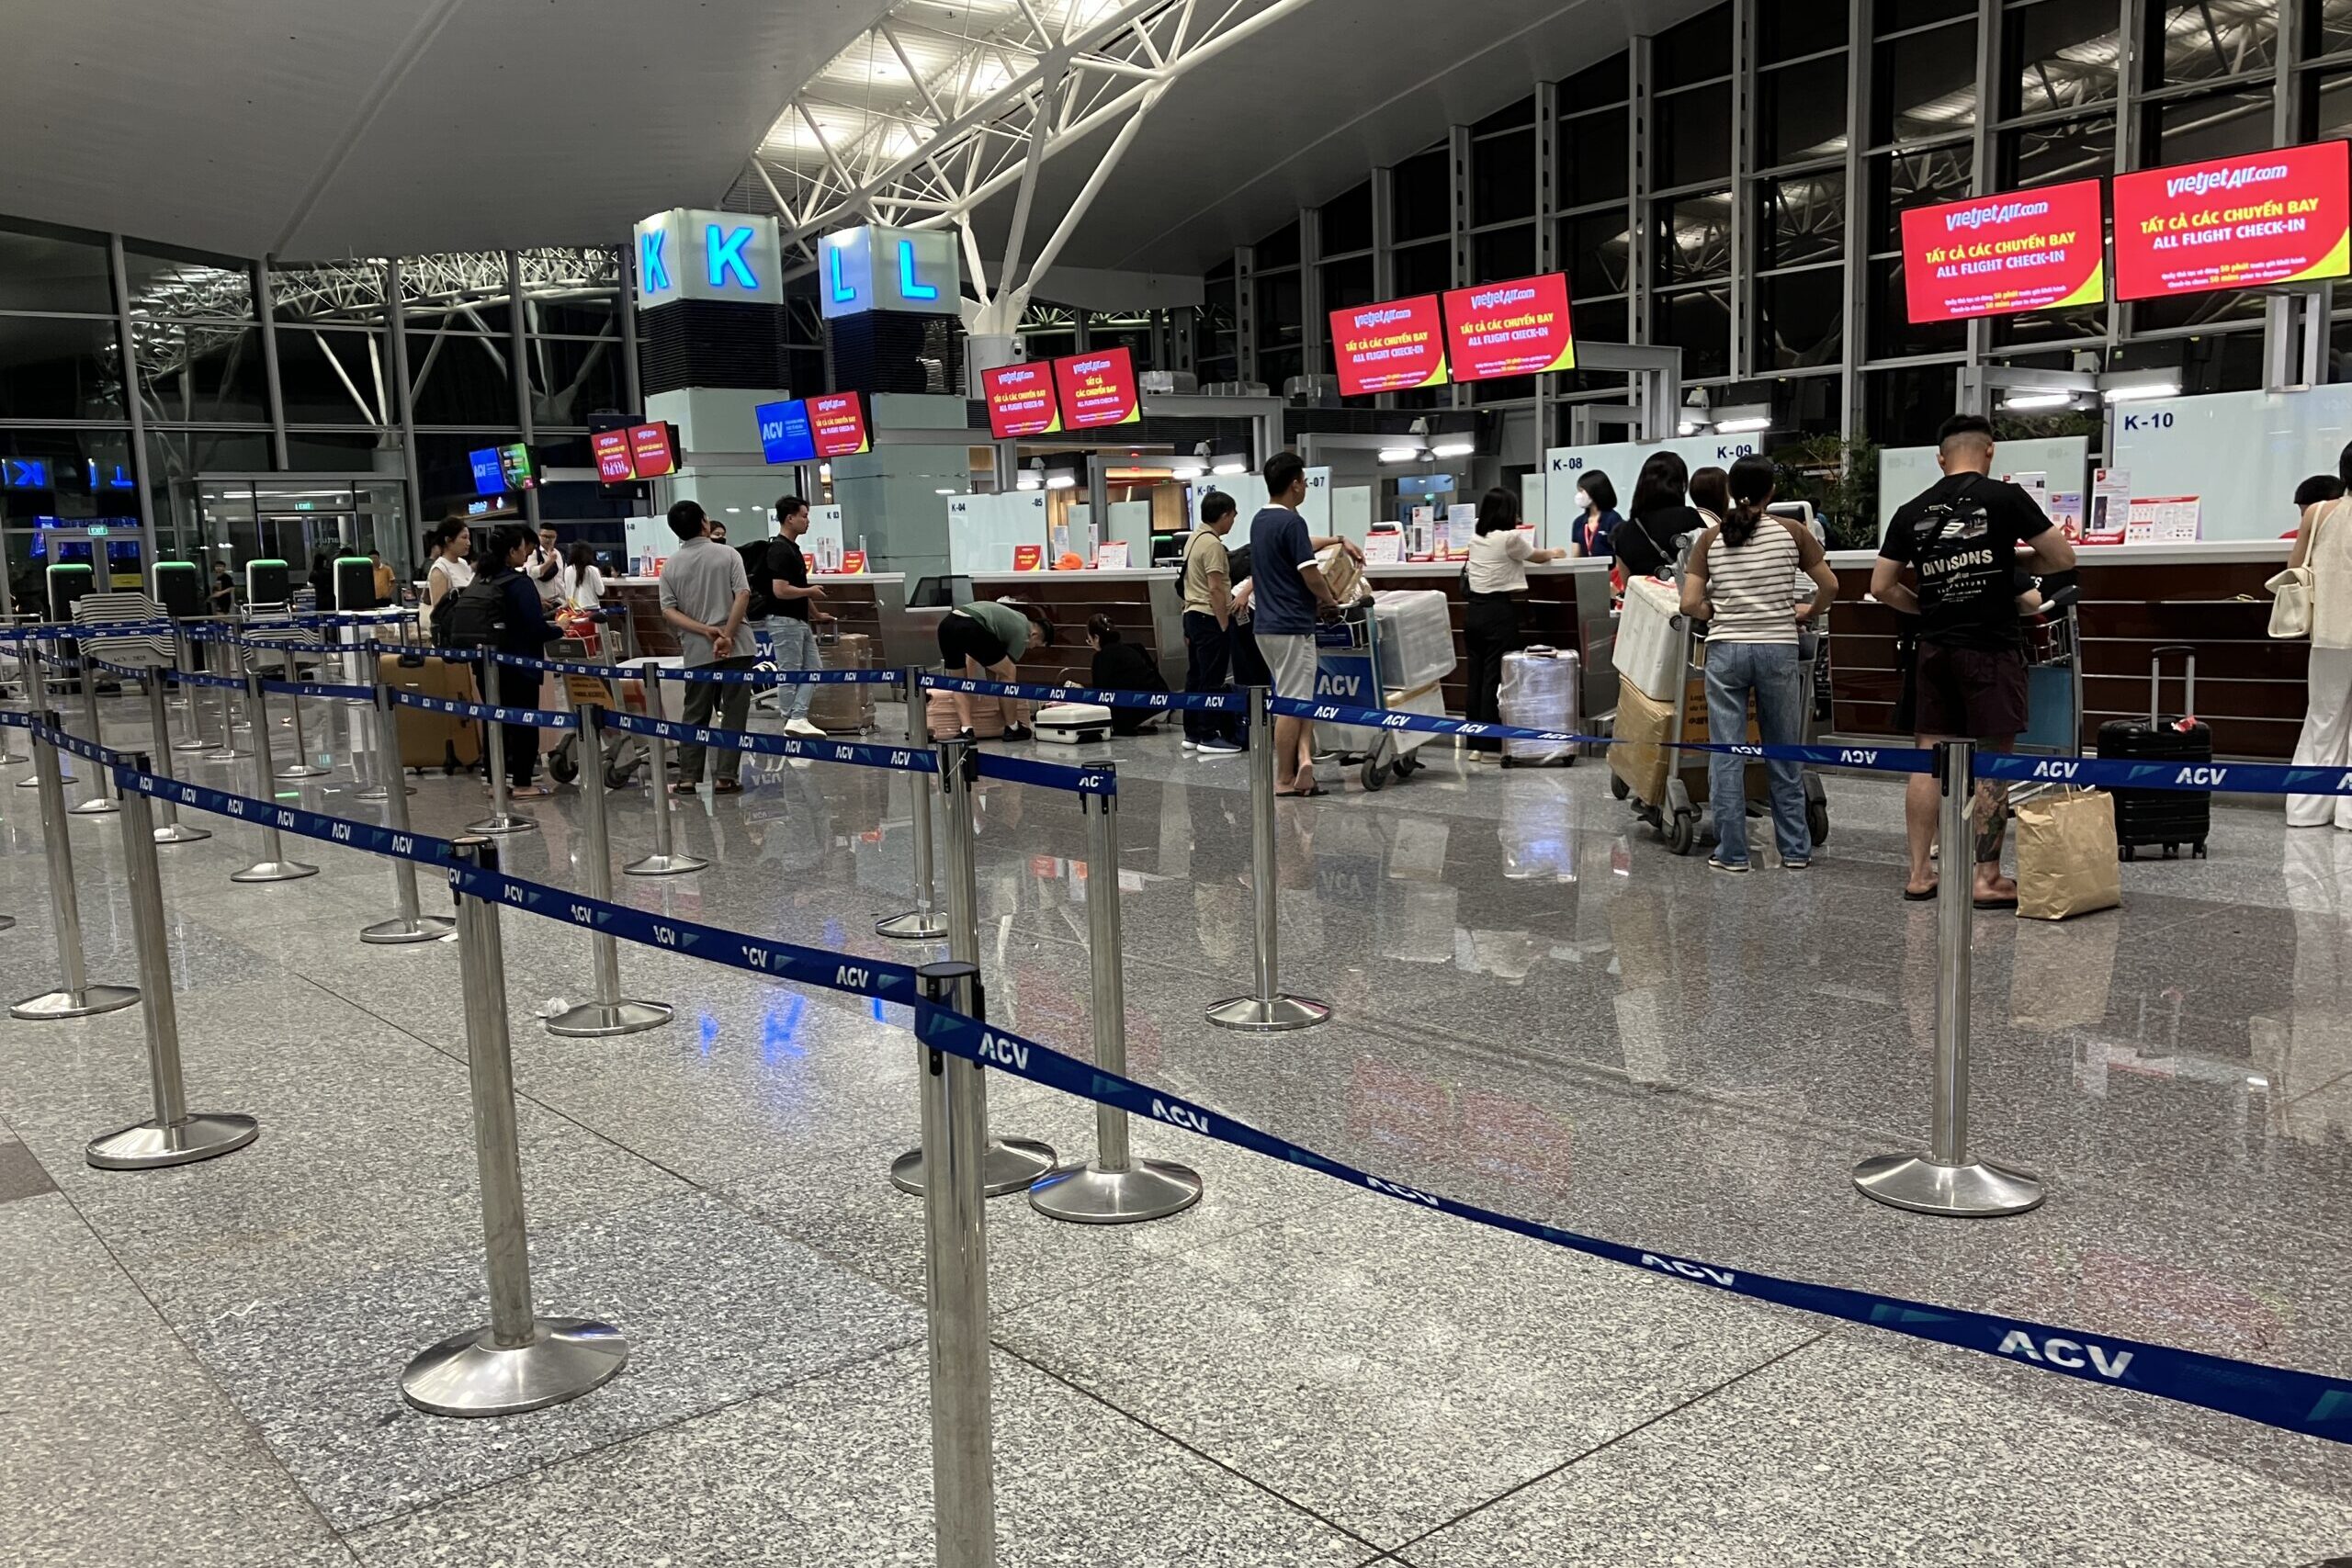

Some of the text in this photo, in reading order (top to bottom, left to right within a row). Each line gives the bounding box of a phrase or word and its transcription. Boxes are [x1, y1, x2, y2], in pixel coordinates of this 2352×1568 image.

[2288, 197, 2319, 214] BAY
[2049, 231, 2076, 246] BAY
[2153, 218, 2306, 250] ALL FLIGHT CHECK-IN
[642, 230, 669, 294] K
[706, 224, 758, 289] K
[898, 240, 938, 300] L
[1936, 249, 2065, 278] ALL FLIGHT CHECK-IN
[830, 246, 856, 303] L
[1468, 337, 1482, 346] ALL
[1484, 332, 1510, 344] FLIGHT
[763, 422, 783, 441] ACV
[2123, 412, 2174, 431] K-10
[1553, 457, 1583, 471] K-08
[1716, 444, 1752, 459] K-09
[755, 642, 774, 657] CV
[921, 675, 1225, 707] ACV ACV ACV ACV ACV ACV ACV
[1317, 674, 1360, 697] ACV
[1314, 705, 1340, 719] ACV
[1382, 714, 1411, 727] ACV
[1456, 723, 1489, 734] ACV
[619, 716, 910, 766] ACV ACV ACV ACV ACV ACV ACV
[1079, 775, 1103, 788] AC
[2033, 761, 2227, 785] ACV ACV
[139, 776, 413, 854] ACV ACV ACV ACV ACV ACV
[448, 867, 460, 885] CV
[503, 884, 523, 904] ACV
[836, 965, 869, 988] ACV
[978, 1032, 2135, 1380] ACV ACV ACV ACV ACV
